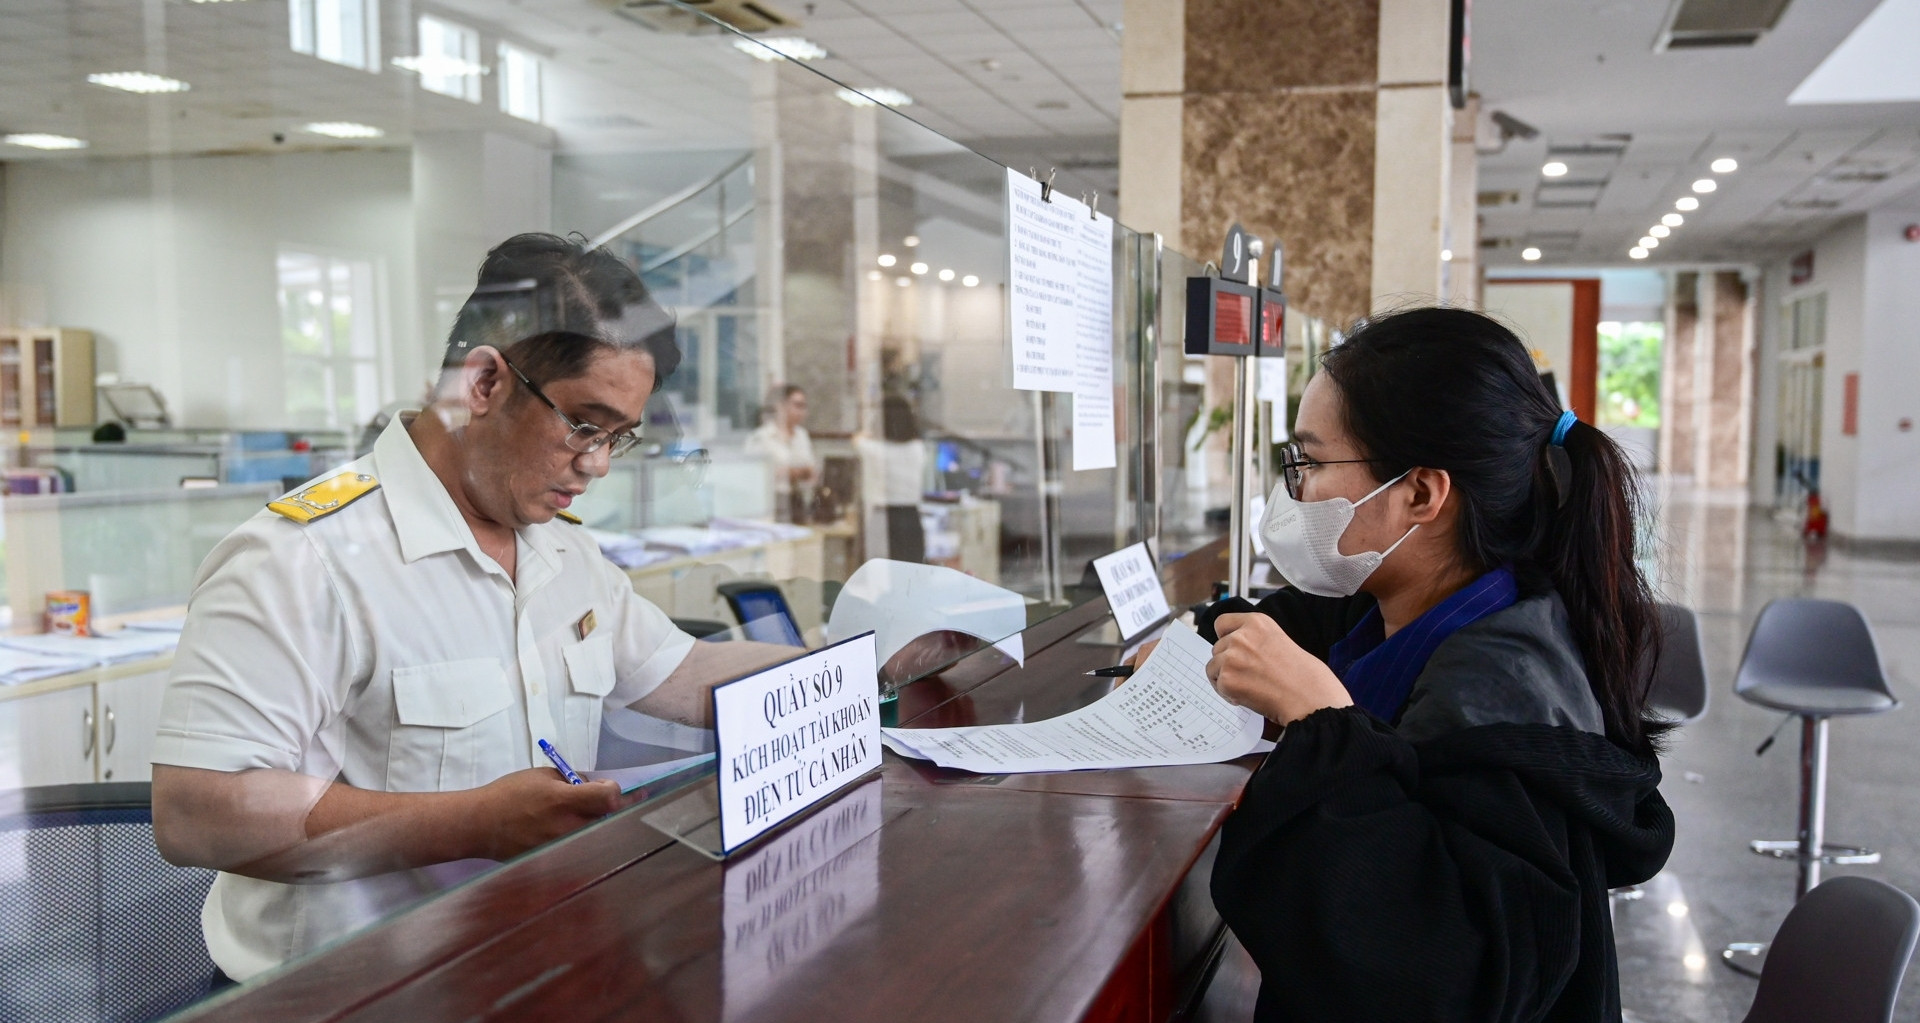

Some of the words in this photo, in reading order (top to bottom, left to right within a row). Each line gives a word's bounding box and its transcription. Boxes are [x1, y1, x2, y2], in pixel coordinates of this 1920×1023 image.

[1232, 232, 1242, 274] 9
[764, 673, 810, 729] QUẦY
[814, 660, 833, 703] SỐ
[834, 664, 843, 695] 9
[731, 742, 768, 783] KÍCH
[771, 725, 807, 760] HOẠT
[811, 713, 830, 746] TÀI
[832, 693, 872, 734] KHOẢN
[744, 776, 782, 826] ĐIỆN
[785, 757, 807, 802] TỬ
[809, 747, 828, 789] CÁ
[831, 732, 869, 778] NHÂN
